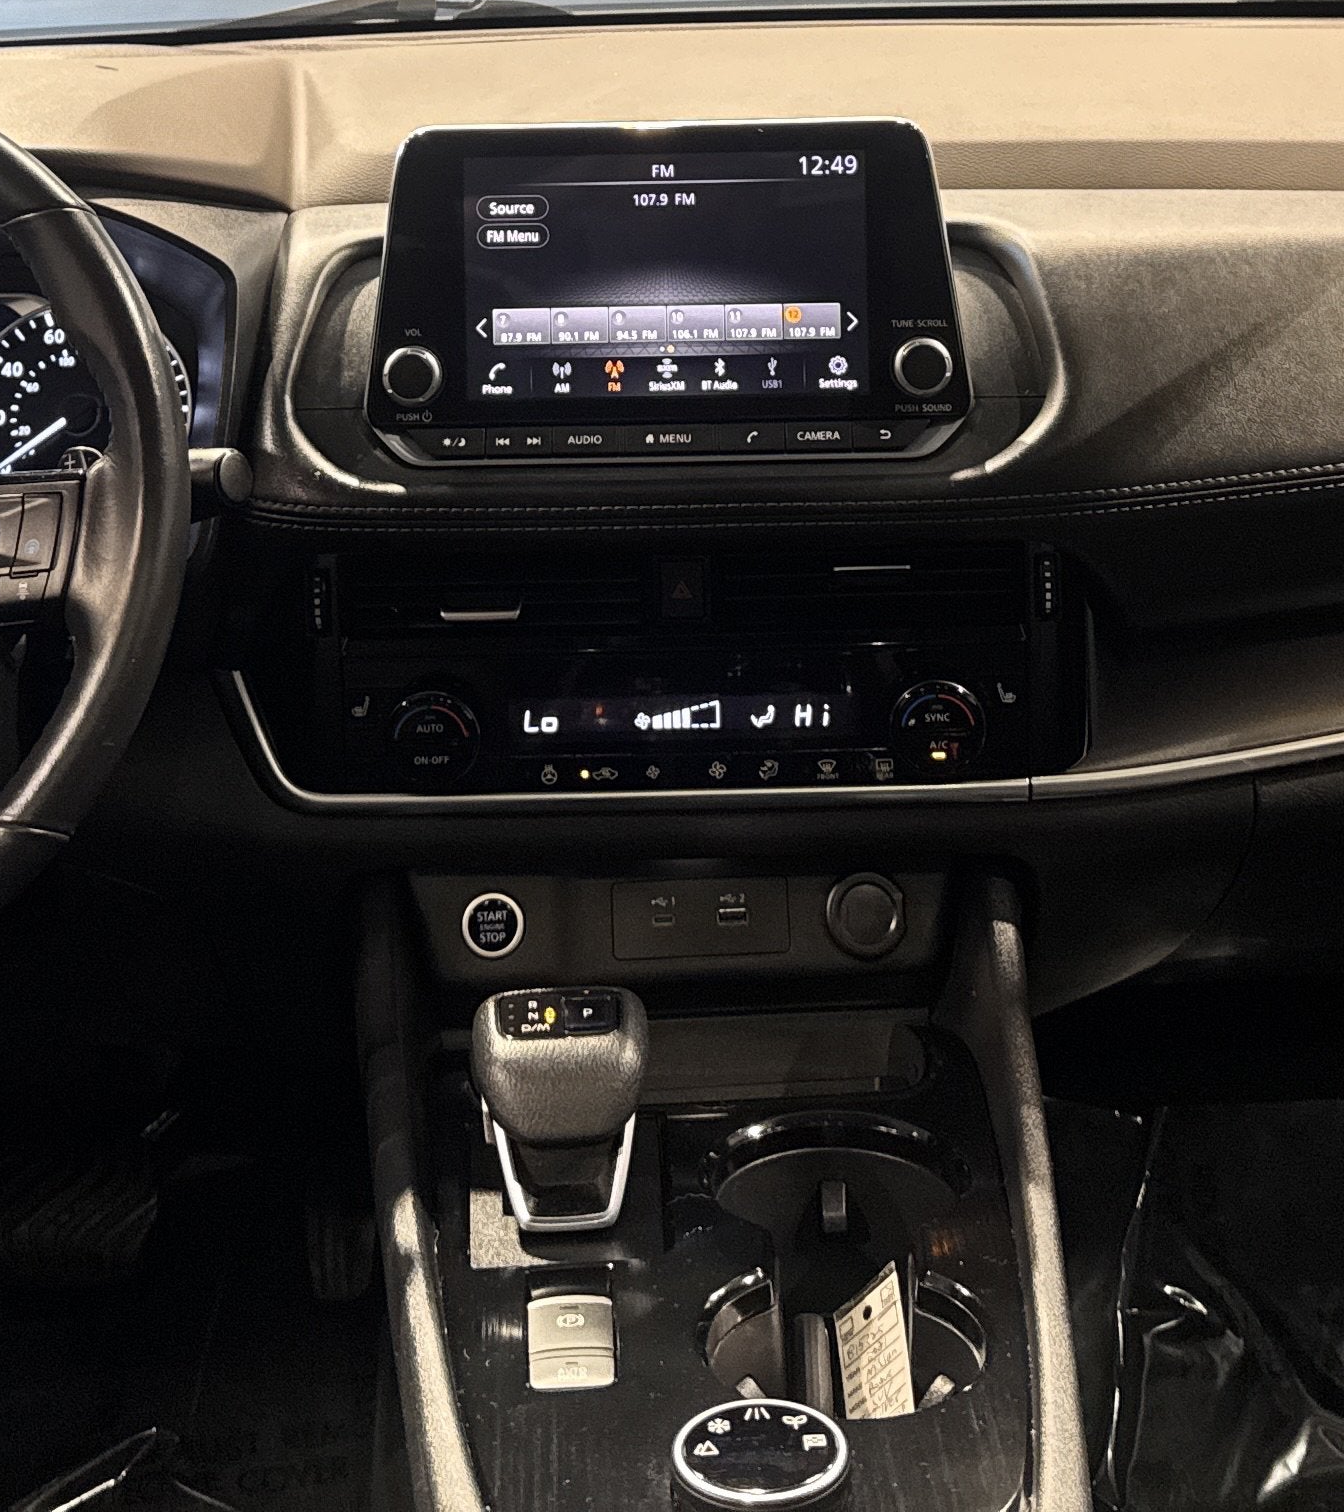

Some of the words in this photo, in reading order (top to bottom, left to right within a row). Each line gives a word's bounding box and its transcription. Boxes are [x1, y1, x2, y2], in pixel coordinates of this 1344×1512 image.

[798, 154, 857, 176] 12:49
[651, 164, 675, 178] FM
[633, 193, 669, 207] 107.9
[674, 192, 696, 206] FM
[489, 201, 535, 216] Source
[486, 229, 504, 243] FM
[506, 229, 539, 243] Menu
[729, 310, 741, 321] 11
[43, 328, 66, 344] 60
[404, 327, 422, 337] VOL
[526, 332, 542, 342] FM
[583, 331, 600, 341] FM
[642, 329, 658, 340] FM
[672, 329, 698, 339] 106.1
[703, 328, 719, 339] FM
[730, 328, 756, 338] 107.9
[761, 327, 777, 338] FM
[789, 327, 816, 338] 107.9
[820, 326, 836, 337] FM
[0, 361, 24, 377] 40
[481, 384, 513, 395] Phone
[553, 382, 570, 394] AM
[607, 381, 621, 392] FM
[701, 380, 712, 391] BT
[712, 379, 739, 391] Audio
[761, 379, 783, 389] USB1
[818, 377, 858, 391] Settings
[894, 403, 919, 413] PUSH
[921, 403, 953, 413] SOUND
[396, 412, 420, 422] PUSH
[567, 434, 603, 446] AUDIO
[659, 433, 692, 444] MENU
[796, 431, 841, 441] CAMERA
[523, 709, 559, 733] Lo
[924, 712, 951, 723] SYNC
[415, 723, 444, 734] AUTO
[929, 740, 948, 749] A/C
[476, 910, 507, 922] START
[479, 932, 506, 943] STOP
[527, 1011, 539, 1021] N
[582, 1007, 593, 1019] P
